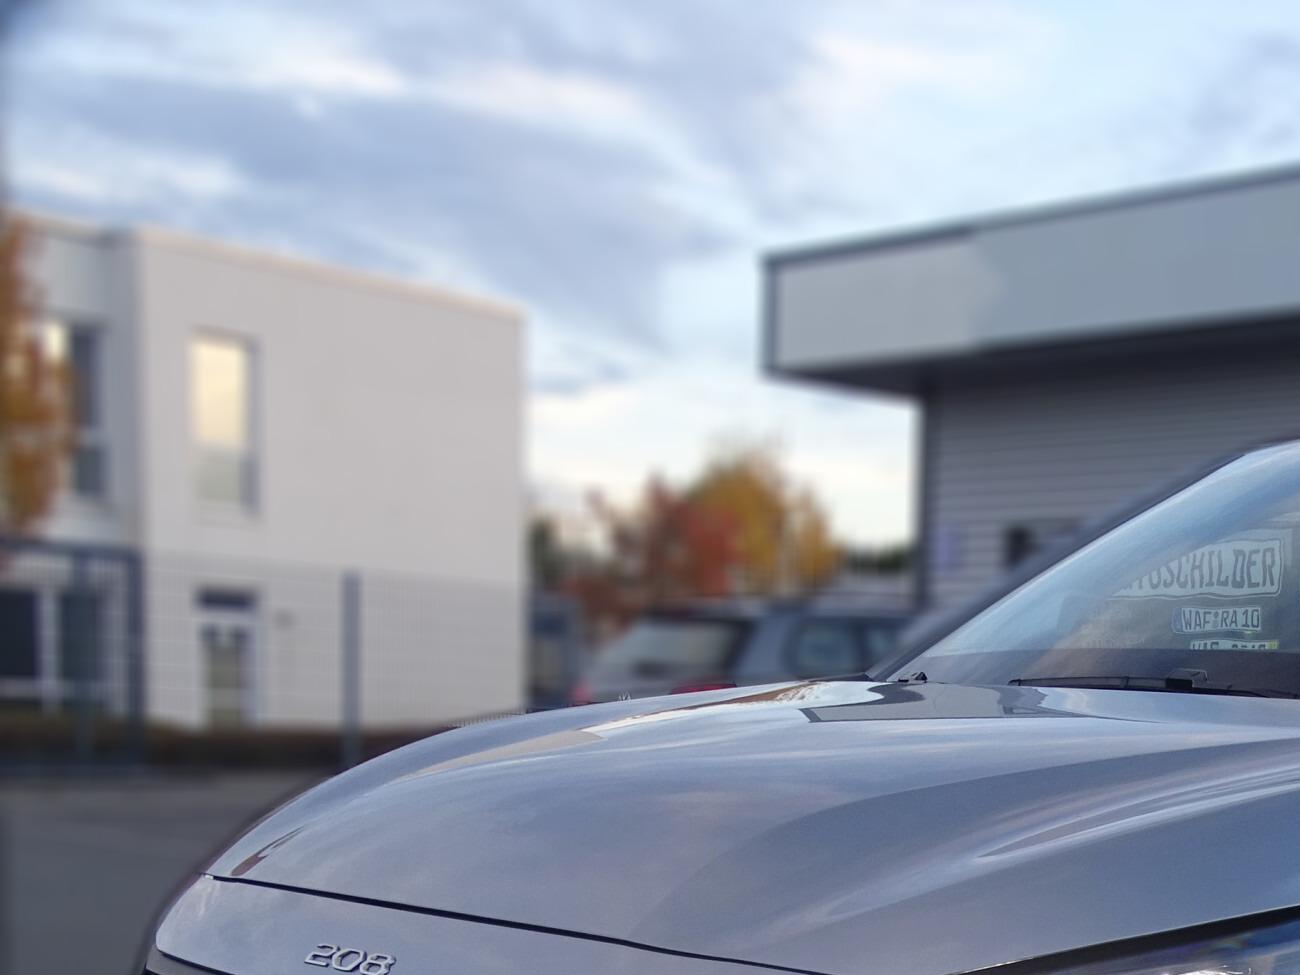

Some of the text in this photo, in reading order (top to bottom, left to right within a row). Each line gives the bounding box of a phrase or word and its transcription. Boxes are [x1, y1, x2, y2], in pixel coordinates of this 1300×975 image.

[1182, 608, 1260, 631] WAF RA 10
